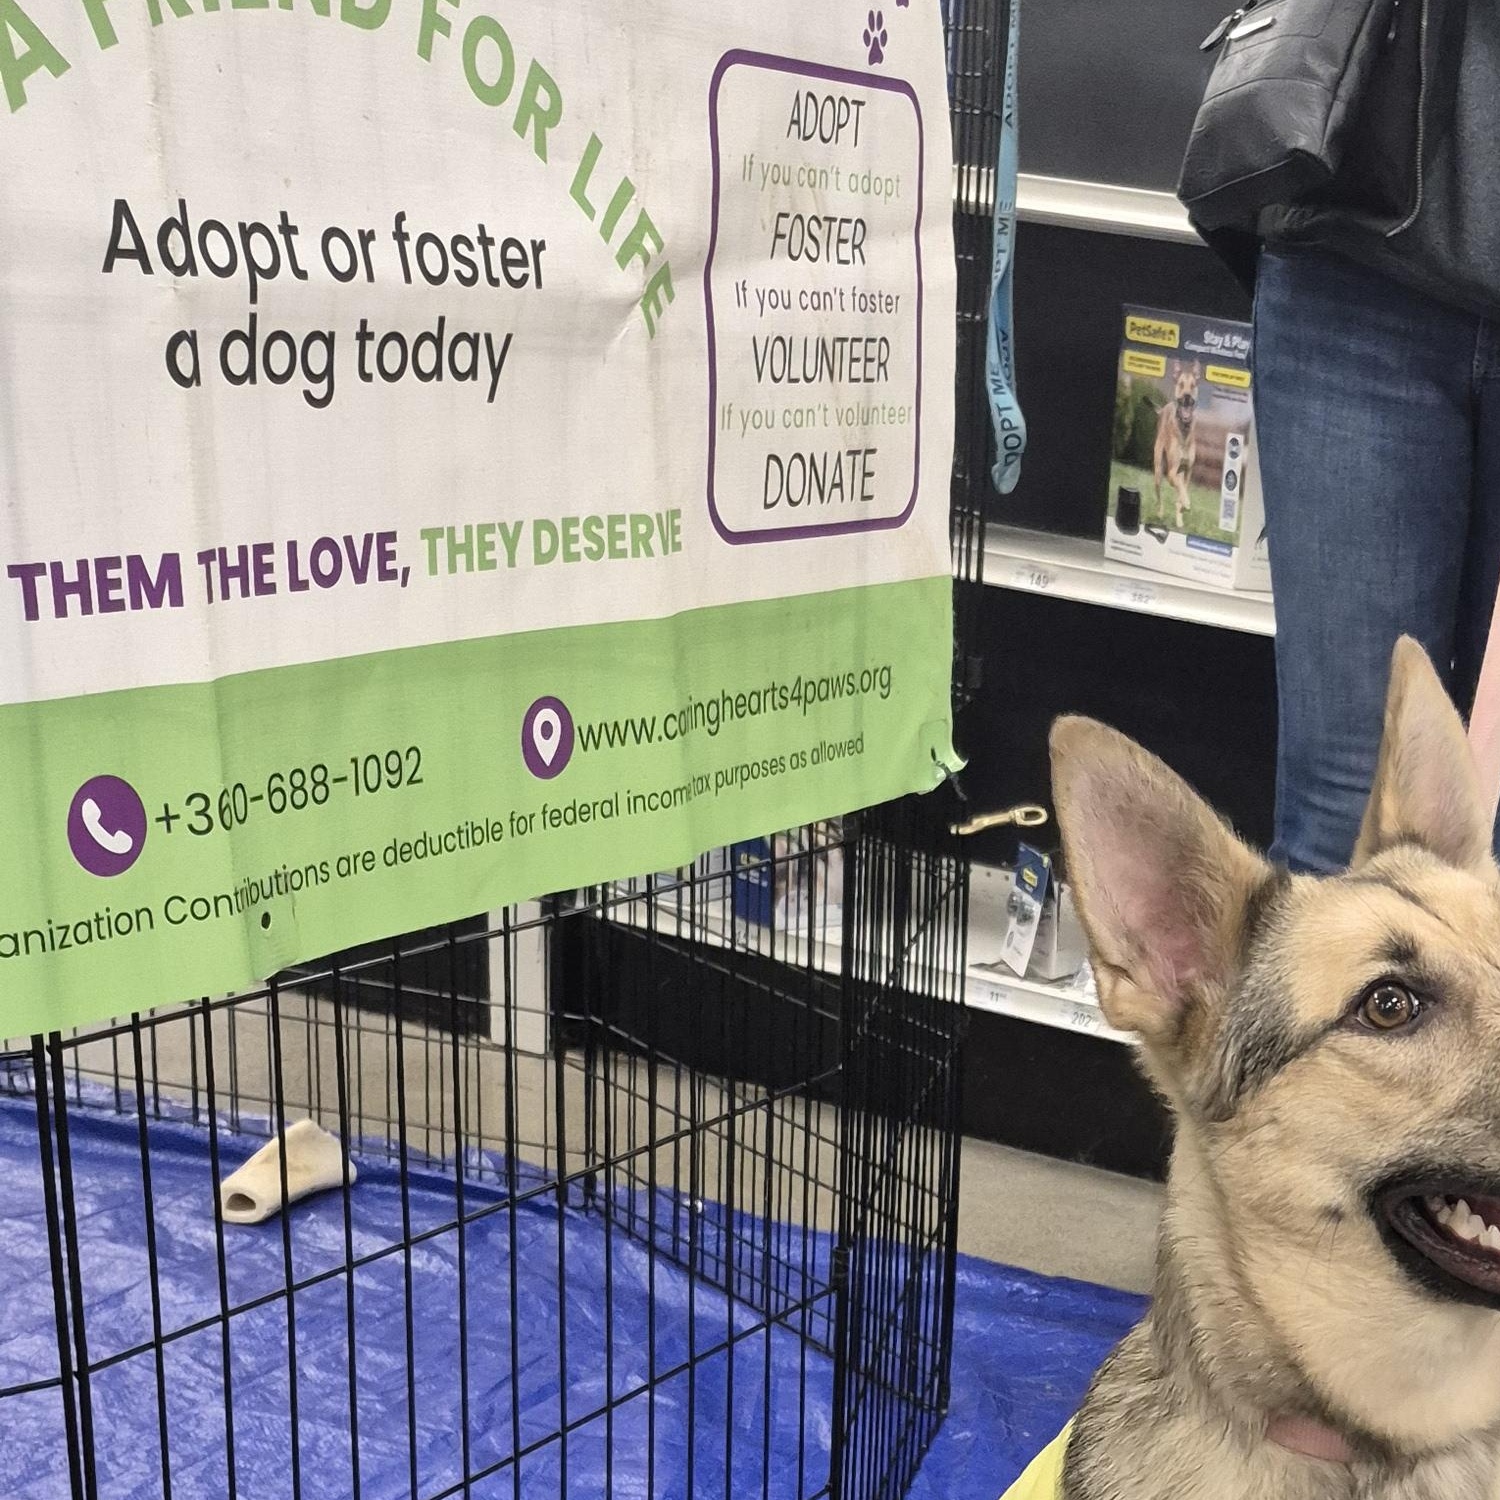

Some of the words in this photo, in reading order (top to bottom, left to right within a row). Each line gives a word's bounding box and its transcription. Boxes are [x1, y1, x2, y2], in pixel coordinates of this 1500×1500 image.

[787, 90, 866, 147] ADOPT
[417, 0, 562, 164] FOR
[569, 131, 675, 340] LIFE
[742, 153, 754, 182] If
[761, 162, 791, 191] you
[798, 165, 841, 191] can't
[848, 170, 900, 204] adopt
[102, 198, 308, 304] Adopt
[322, 226, 376, 282] or
[392, 210, 546, 289] foster
[770, 212, 867, 266] FOSTER
[735, 280, 748, 308] If
[756, 288, 791, 317] you
[799, 287, 845, 312] can't
[852, 286, 900, 314] foster
[166, 329, 201, 388] a
[219, 312, 335, 409] dog
[356, 316, 513, 403] today
[753, 335, 890, 383] VOLUNTEER
[721, 403, 733, 430] If
[740, 407, 775, 438] you
[783, 404, 828, 429] can't
[836, 402, 912, 427] volunteer
[764, 448, 877, 509] DONATE
[8, 553, 184, 621] THEM
[198, 542, 277, 604] THE
[287, 531, 411, 592] LOVE,
[421, 521, 523, 576] THEY
[533, 509, 682, 566] DESERVE
[578, 665, 891, 751] www.caringhearts4paws.org
[155, 746, 424, 836] +360-688-1092
[164, 860, 331, 926] Contributions
[337, 848, 376, 878] are
[383, 813, 503, 866] deductible
[509, 806, 535, 838] for
[542, 792, 619, 831] federal
[627, 782, 692, 815] income
[692, 772, 711, 797] tax
[715, 755, 786, 796] purposes
[790, 749, 806, 769] as
[811, 733, 864, 765] allowed
